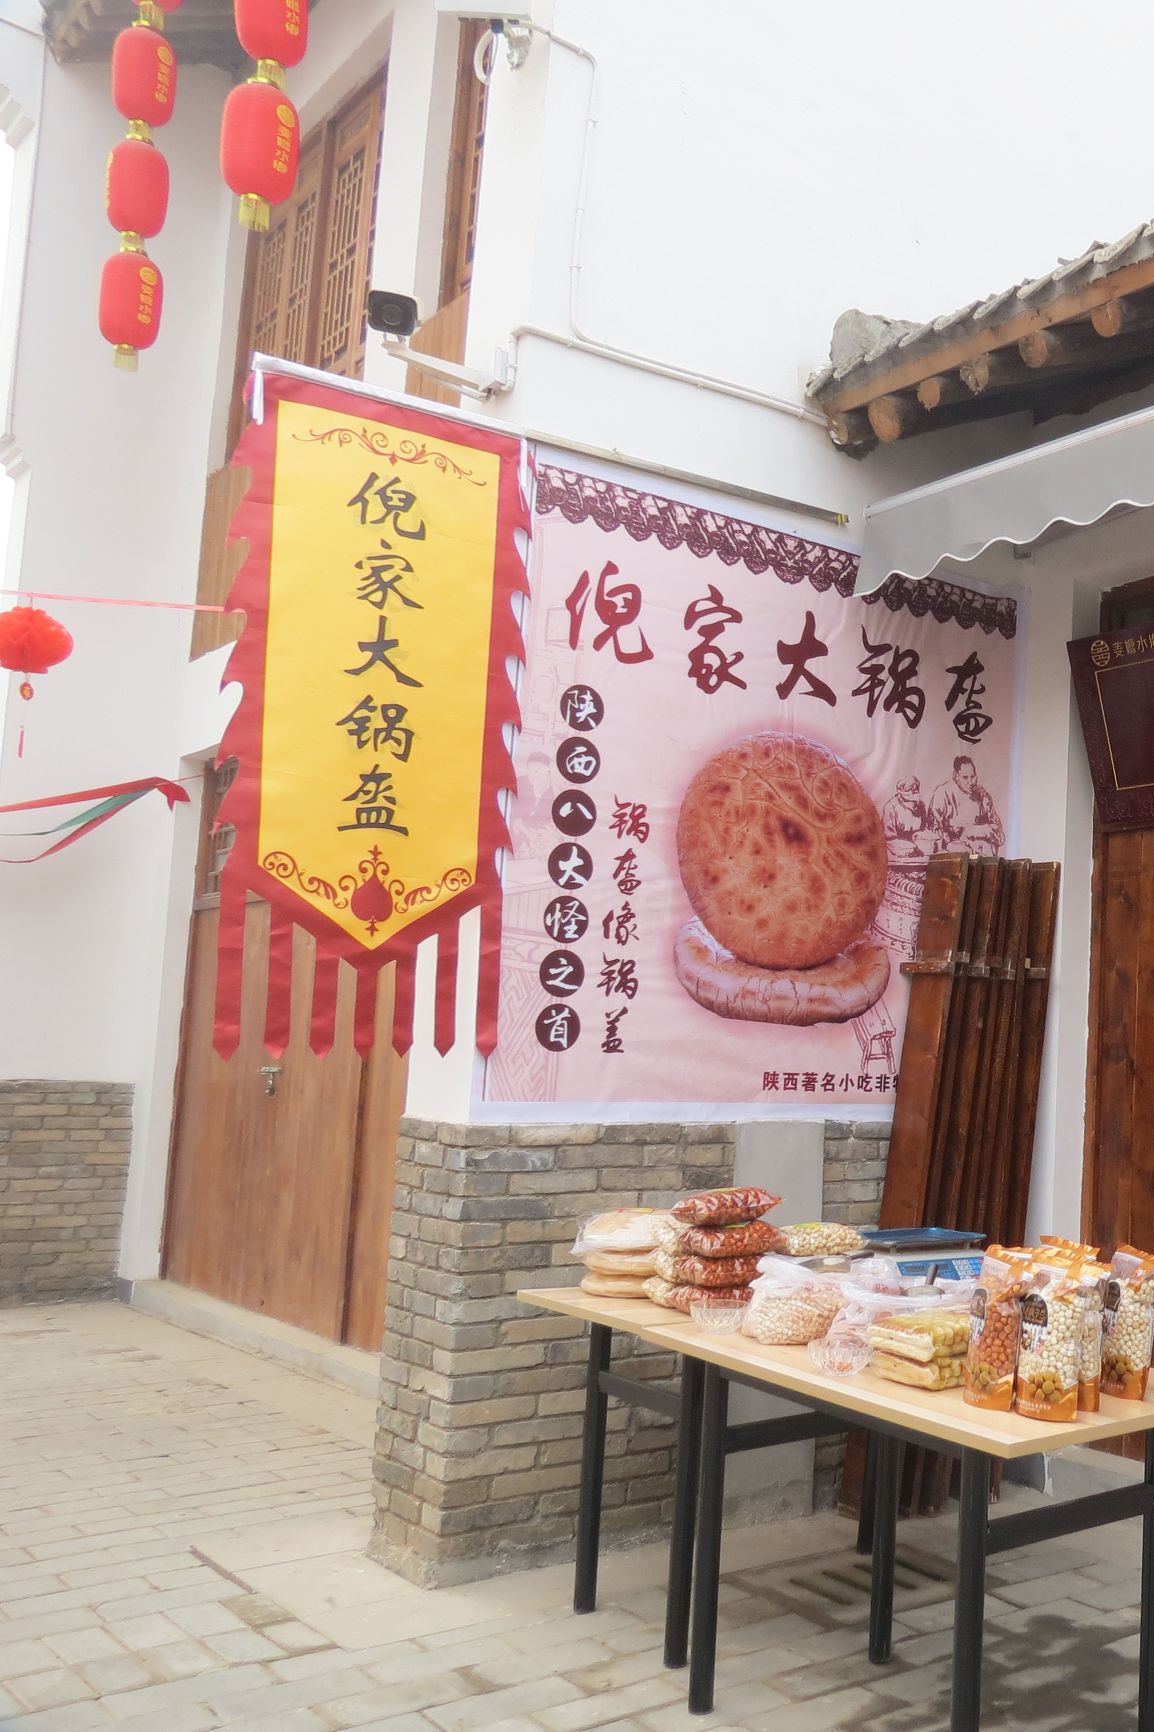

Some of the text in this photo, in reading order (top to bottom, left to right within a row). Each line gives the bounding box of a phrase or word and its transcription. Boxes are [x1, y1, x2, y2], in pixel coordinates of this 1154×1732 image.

[336, 471, 426, 838] 倪家大锅盔
[565, 560, 994, 745] 倪家大锅盔
[542, 688, 598, 1050] 陕西八大怪之首
[596, 794, 651, 1054] 锅盔像锅盖
